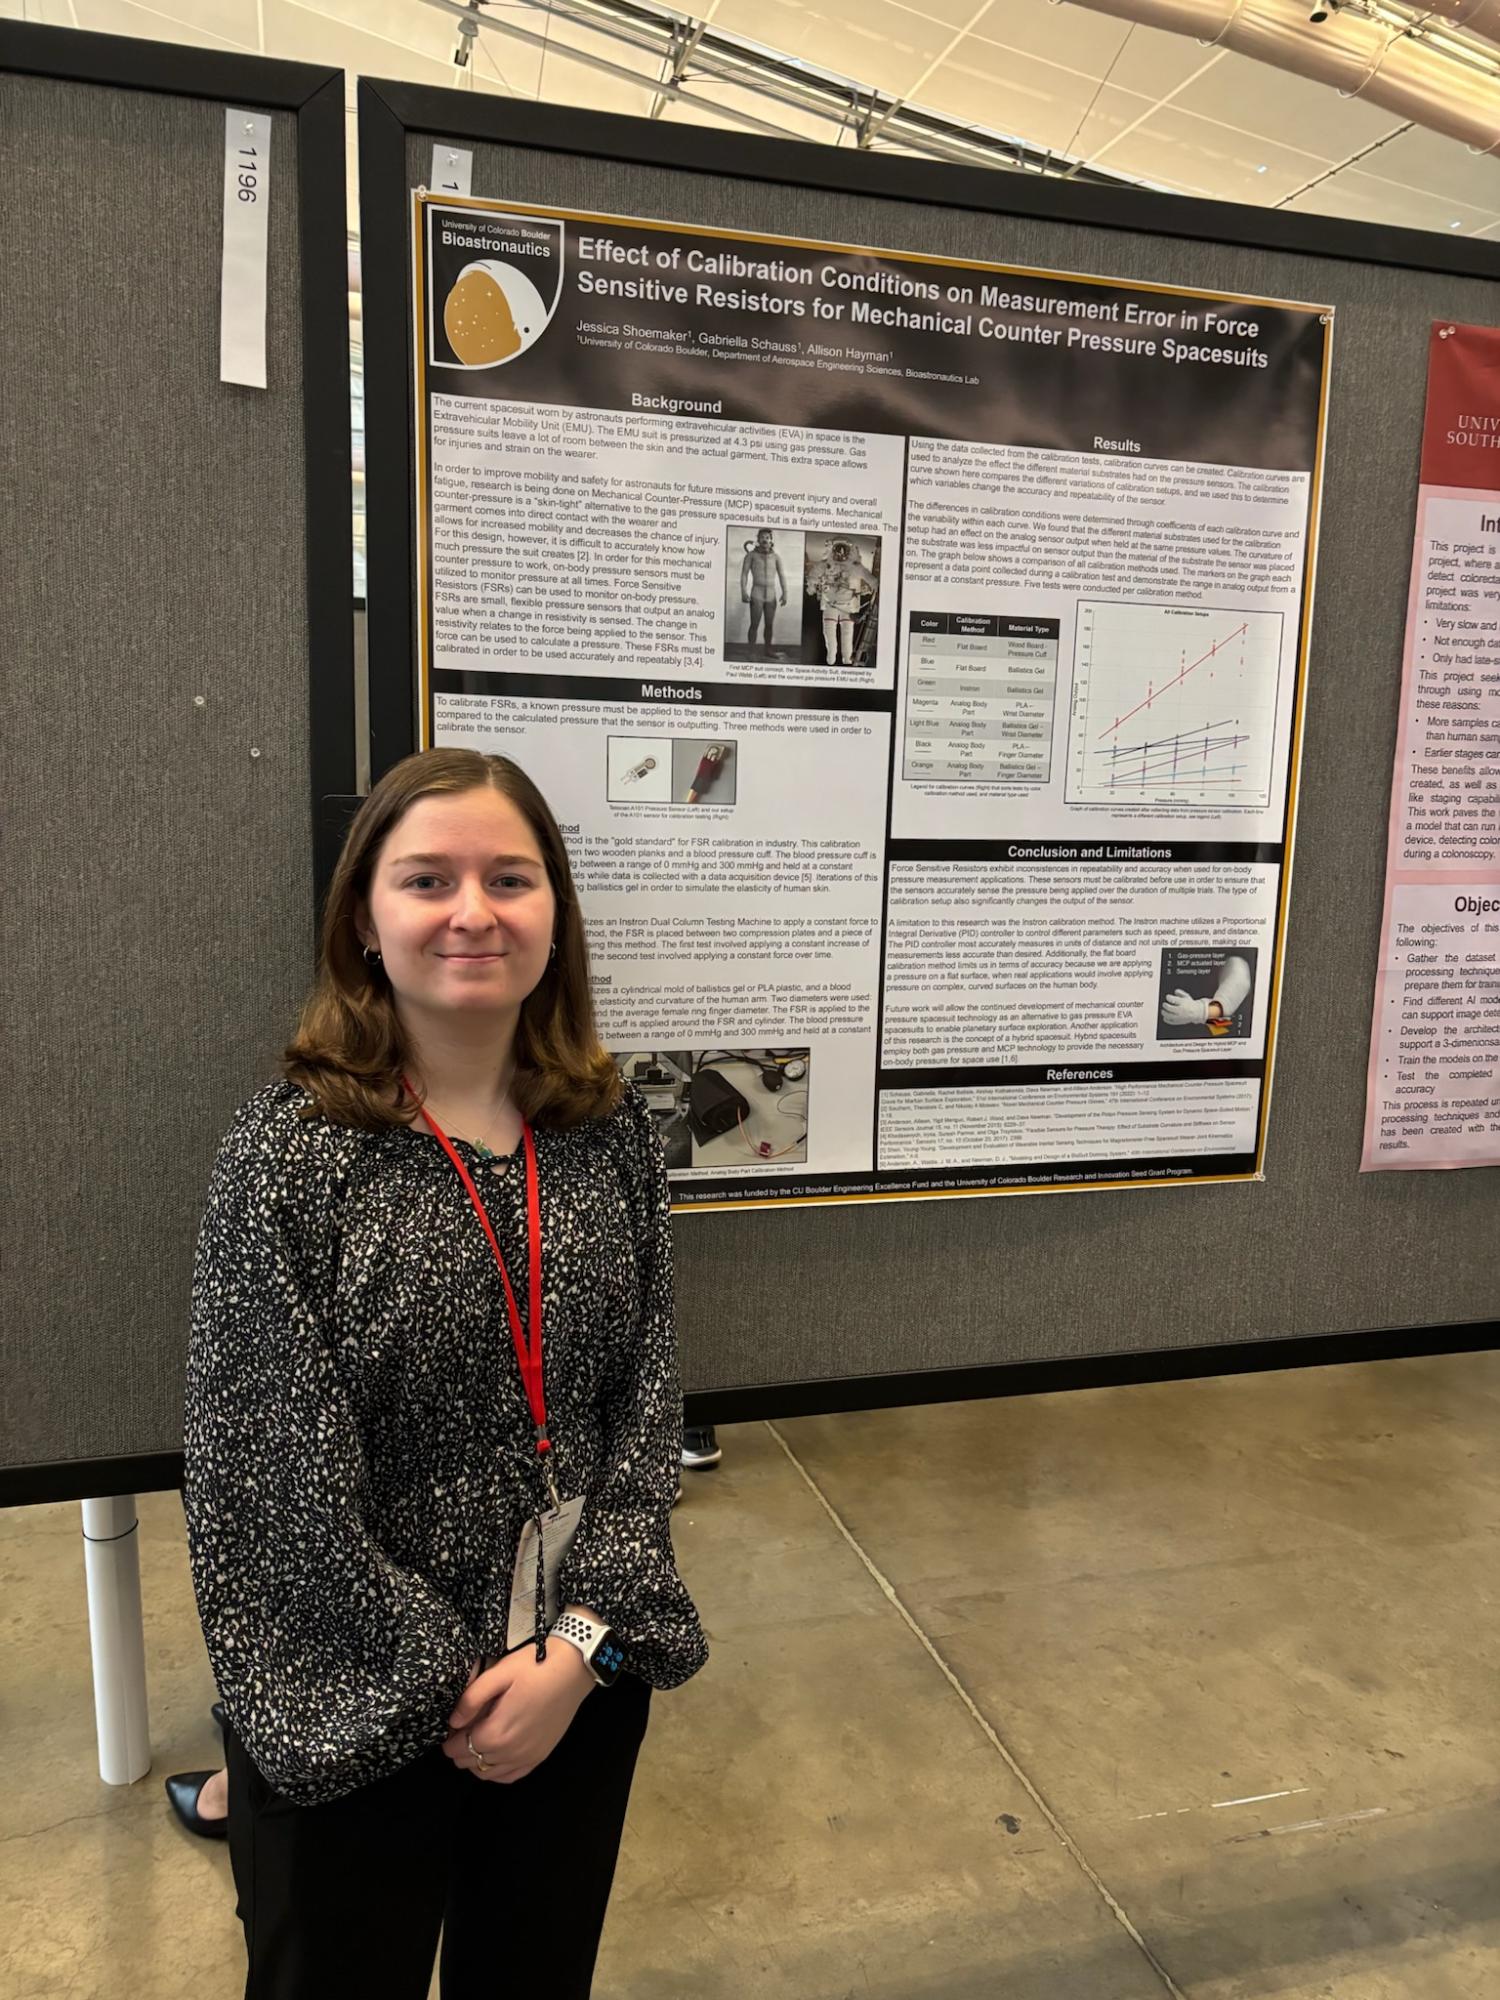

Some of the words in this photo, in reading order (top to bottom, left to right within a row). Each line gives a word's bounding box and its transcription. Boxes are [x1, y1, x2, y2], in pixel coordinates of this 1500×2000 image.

[237, 147, 257, 203] 1196
[442, 220, 477, 233] University
[478, 224, 486, 233] of
[486, 225, 520, 237] Colorado
[520, 229, 550, 240] Boulder
[442, 231, 551, 258] Bioastronautics
[578, 236, 648, 265] Effect
[656, 248, 681, 270] of
[686, 249, 813, 284] Calibration
[820, 265, 940, 300] Conditions
[947, 286, 973, 304] on
[980, 285, 1118, 322] Measurement
[1124, 303, 1176, 329] Error
[1180, 310, 1198, 331] in
[1204, 313, 1259, 338] Force
[577, 271, 688, 304] Sensitive
[696, 284, 805, 316] Resistors
[812, 298, 844, 321] for
[851, 301, 972, 335] Mechanical
[978, 317, 1062, 346] Counter
[1068, 327, 1156, 357] Pressure
[1162, 338, 1268, 369] Spacesuits
[576, 319, 619, 335] Jessica
[698, 332, 748, 348] Gabriella
[806, 342, 844, 358] Allison
[623, 340, 634, 350] of
[633, 341, 674, 354] Colorado
[675, 345, 709, 358] Boulder,
[712, 349, 760, 363] Department
[761, 354, 770, 363] of
[770, 354, 816, 369] Aerospace
[815, 359, 865, 374] Engineering
[905, 368, 963, 383] Bioastronautics
[964, 374, 980, 385] Lab
[631, 393, 722, 413] Background
[434, 398, 452, 408] The
[453, 399, 487, 411] current
[489, 402, 534, 417] spacesuit
[536, 408, 559, 418] worn
[561, 409, 573, 421] by
[575, 410, 623, 424] astronauts
[625, 415, 673, 430] performing
[674, 419, 736, 433] extravehicular
[738, 424, 776, 437] activities
[778, 428, 803, 441] (EVA)
[805, 430, 813, 440] in
[815, 433, 840, 444] space
[842, 433, 850, 443] is
[851, 434, 865, 444] the
[1458, 415, 1500, 431] UNIV
[434, 435, 446, 446] for
[448, 437, 482, 451] injuries
[484, 441, 502, 452] and
[504, 443, 530, 454] strain
[532, 447, 544, 455] on
[547, 446, 562, 456] the
[1093, 437, 1141, 453] Results
[1447, 430, 1500, 448] SOUTH
[910, 475, 932, 486] which
[934, 478, 970, 490] variables
[971, 481, 1000, 495] change
[1002, 484, 1015, 494] the
[1016, 487, 1052, 499] accuracy
[1053, 489, 1068, 499] and
[1069, 490, 1115, 504] repeatability
[1116, 494, 1124, 503] of
[1126, 494, 1138, 504] the
[435, 579, 478, 591] Resistors
[480, 582, 513, 595] (FSRs)
[515, 586, 532, 595] can
[534, 586, 546, 596] be
[548, 587, 571, 597] used
[573, 588, 582, 598] to
[584, 589, 618, 600] monitor
[620, 591, 656, 604] on-body
[1425, 598, 1472, 612] limitations:
[1436, 618, 1455, 632] Very
[1456, 619, 1478, 631] slow
[1479, 621, 1498, 632] and
[641, 684, 702, 701] Methods
[1416, 698, 1440, 710] these
[1442, 701, 1480, 711] reasons:
[436, 722, 474, 732] calibrate
[476, 723, 491, 733] the
[1008, 846, 1077, 858] Conclusion
[1080, 846, 1103, 858] and
[1106, 847, 1172, 858] Limitations
[1403, 848, 1431, 861] during
[1433, 851, 1439, 859] a
[1441, 849, 1496, 863] colonoscopy.
[1396, 936, 1438, 950] following:
[590, 951, 605, 960] the
[606, 951, 638, 960] second
[638, 951, 655, 960] test
[656, 951, 692, 960] involved
[692, 950, 728, 962] applying
[736, 950, 771, 959] constant
[772, 950, 793, 959] force
[882, 1057, 913, 1069] on-body
[915, 1058, 948, 1068] pressure
[949, 1056, 960, 1065] for
[961, 1056, 984, 1066] space
[1047, 1068, 1114, 1081] References
[1395, 1086, 1435, 1096] accuracy
[1380, 1138, 1410, 1150] results.
[678, 1192, 694, 1201] This
[695, 1190, 726, 1200] research
[743, 1188, 768, 1198] funded
[768, 1188, 778, 1198] by
[779, 1187, 790, 1196] the
[792, 1186, 804, 1195] CU
[804, 1185, 832, 1194] Boulder
[832, 1183, 873, 1194] Engineering
[874, 1181, 910, 1191] Excellence
[911, 1180, 929, 1189] Fund
[930, 1179, 943, 1188] and
[943, 1179, 955, 1187] the
[956, 1177, 988, 1188] University
[988, 1177, 996, 1185] of
[996, 1175, 1026, 1185] Colorado
[1027, 1174, 1052, 1183] Boulder
[1052, 1172, 1083, 1182] Research
[1084, 1172, 1096, 1180] and
[1097, 1170, 1130, 1180] Innovation
[1130, 1169, 1147, 1178] Seed
[1147, 1168, 1165, 1177] Grant
